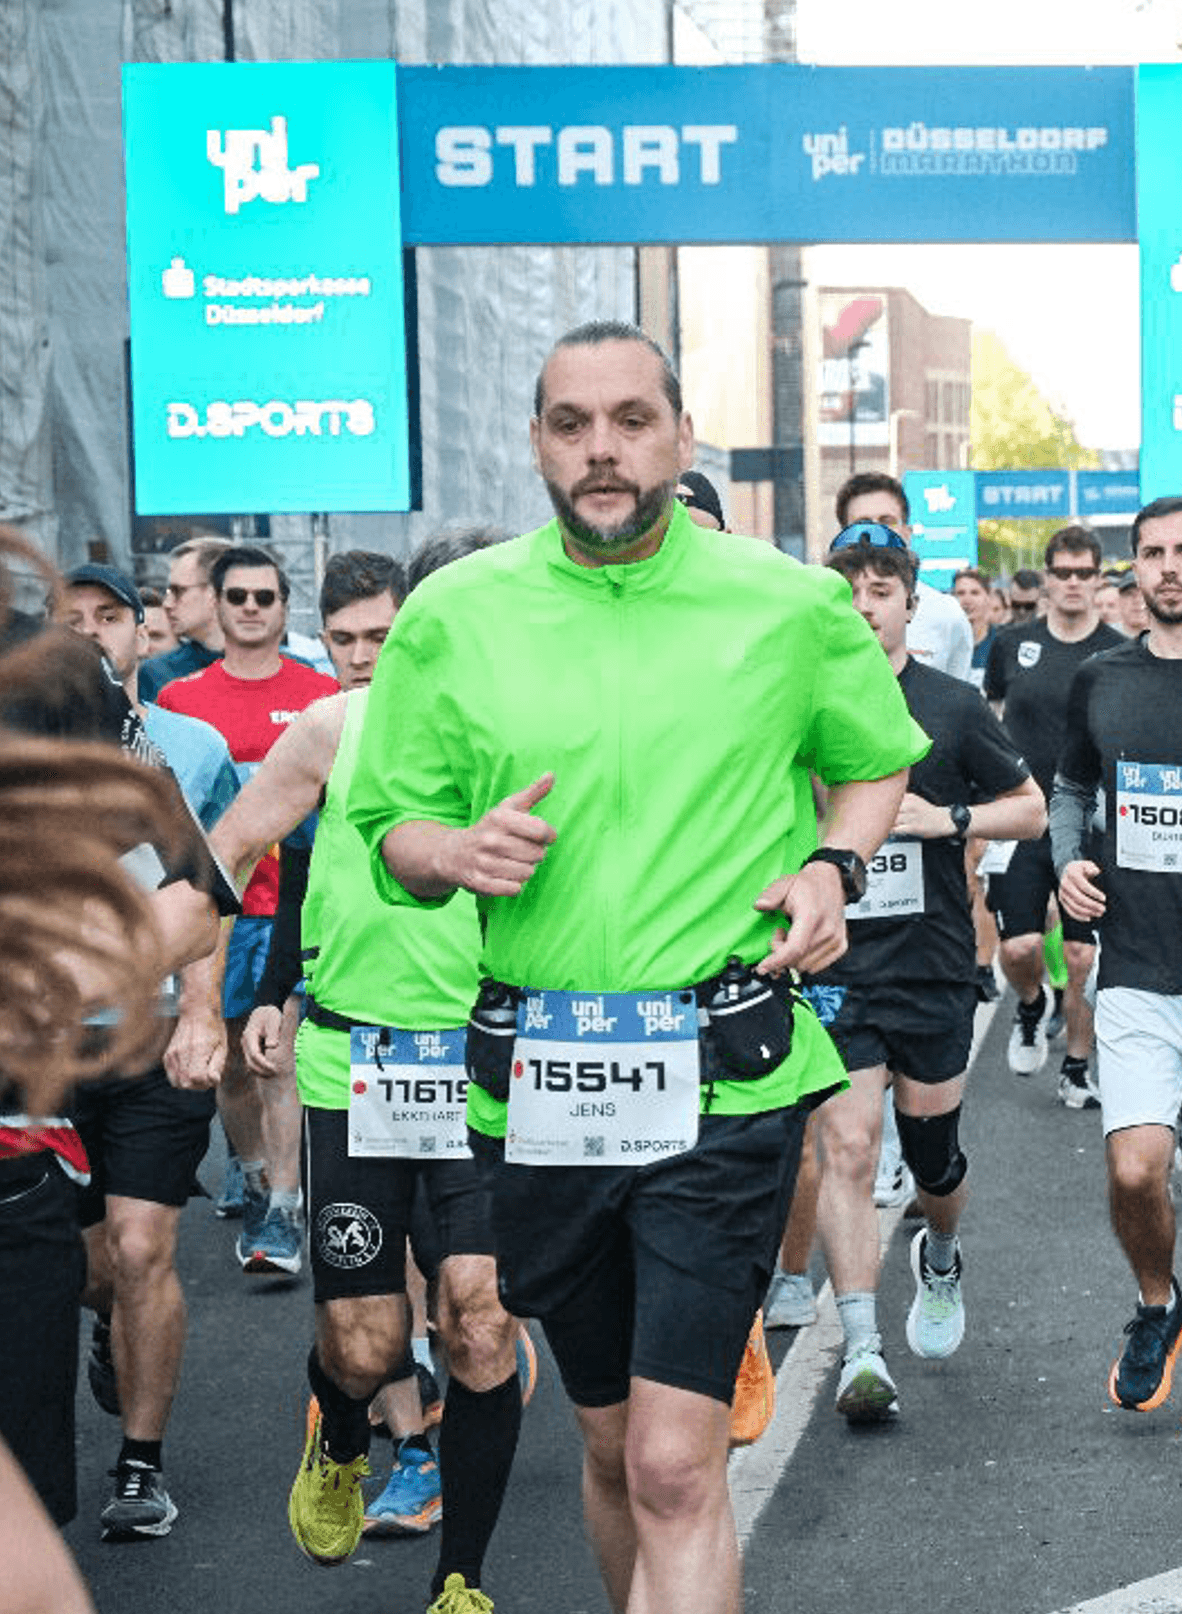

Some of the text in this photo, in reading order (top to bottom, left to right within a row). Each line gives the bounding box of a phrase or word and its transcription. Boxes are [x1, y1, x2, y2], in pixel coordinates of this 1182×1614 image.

[802, 124, 848, 155] uni
[881, 121, 1108, 150] DÜSSELDORF
[435, 125, 738, 186] START
[811, 152, 865, 181] per
[224, 164, 320, 214] per
[206, 302, 324, 324] Düsseldorf
[166, 399, 375, 437] D.SPORTS
[1130, 804, 1182, 826] 150
[571, 996, 604, 1016] uni
[637, 995, 672, 1016] uni
[577, 1015, 618, 1036] per
[645, 1014, 685, 1036] per
[419, 1045, 450, 1060] per
[529, 1060, 665, 1092] 15541
[569, 1102, 616, 1117] JENS
[621, 1139, 687, 1152] D.SPORTS
